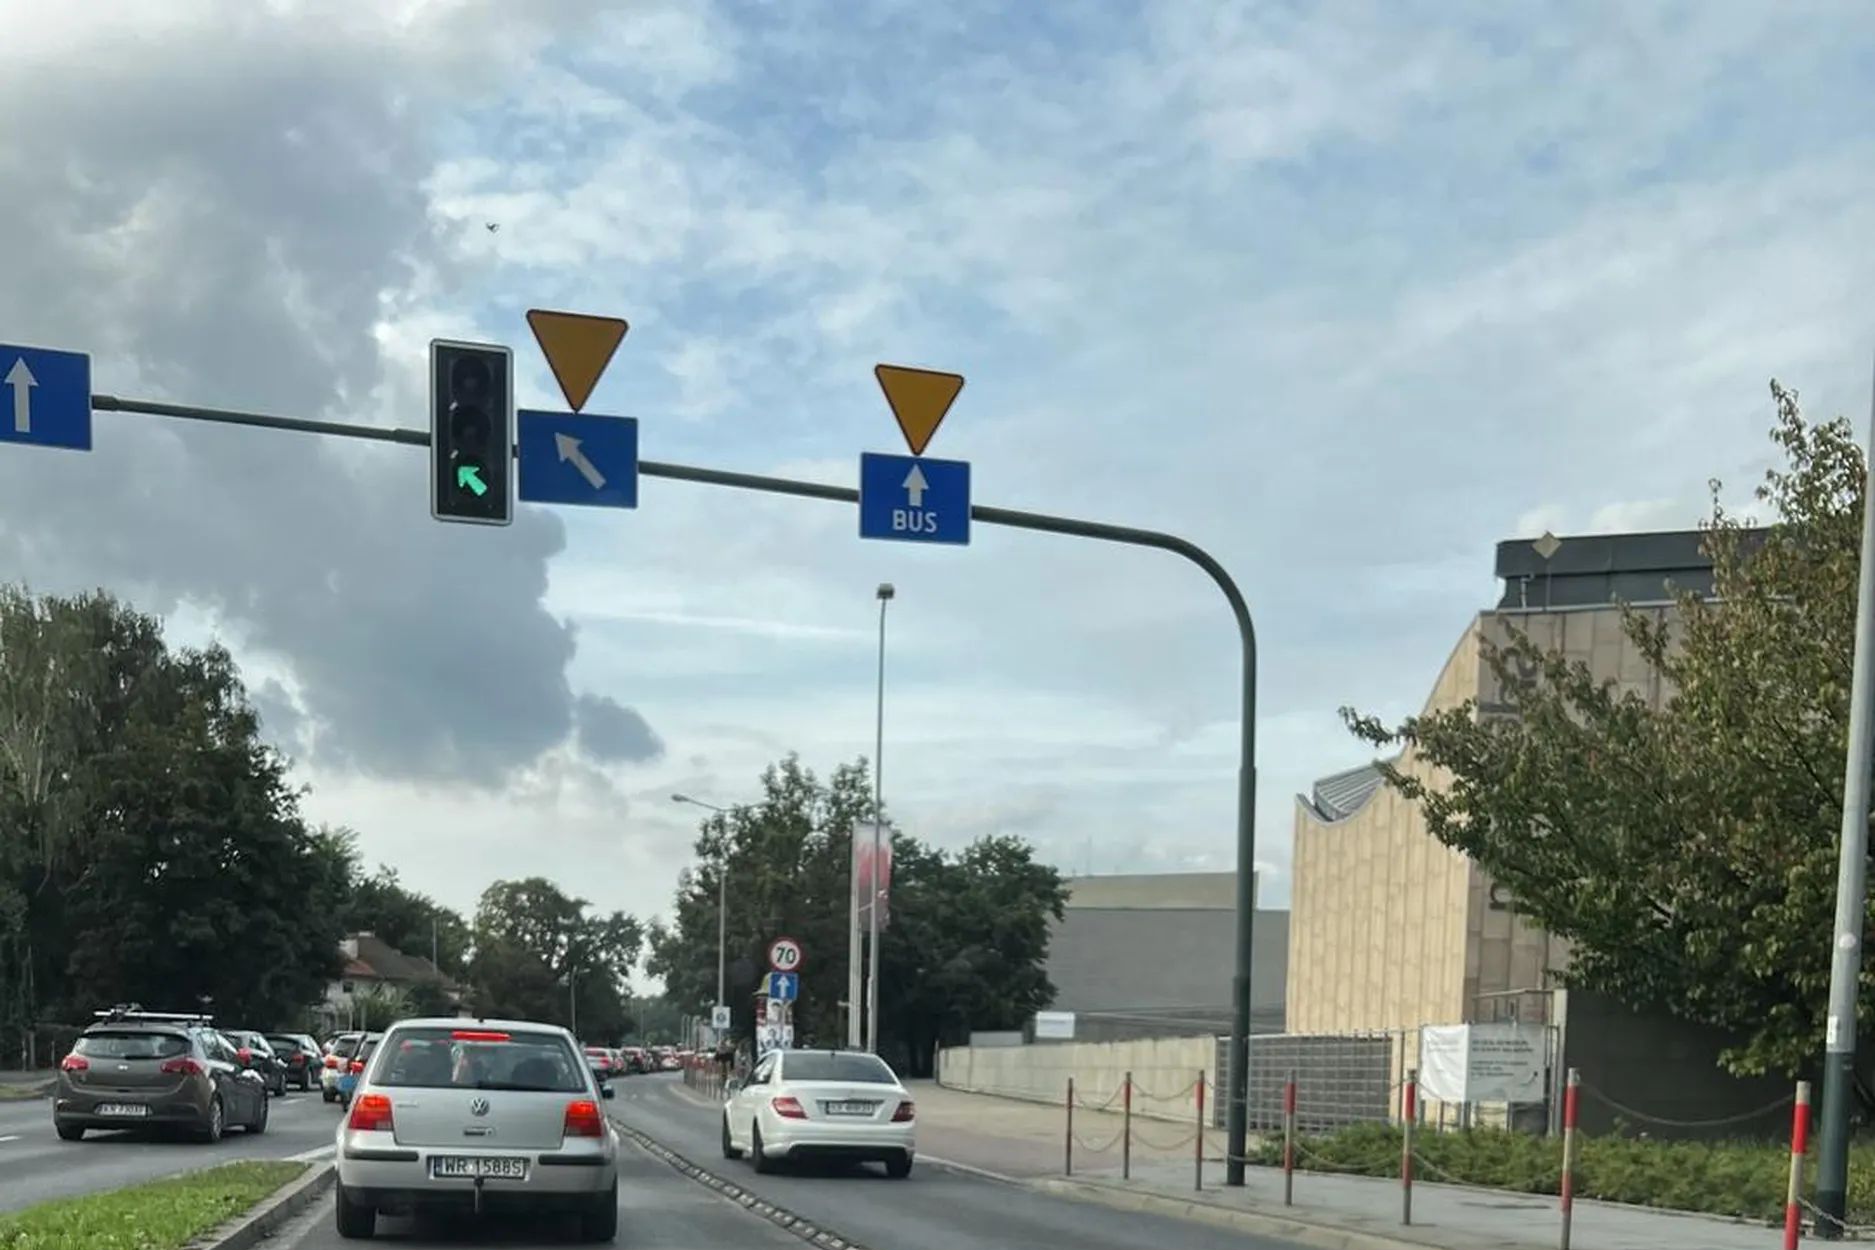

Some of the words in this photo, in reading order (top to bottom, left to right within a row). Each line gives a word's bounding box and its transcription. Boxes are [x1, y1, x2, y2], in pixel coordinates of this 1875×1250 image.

[893, 509, 938, 533] BUS
[776, 946, 797, 965] 70
[445, 1159, 467, 1174] WR
